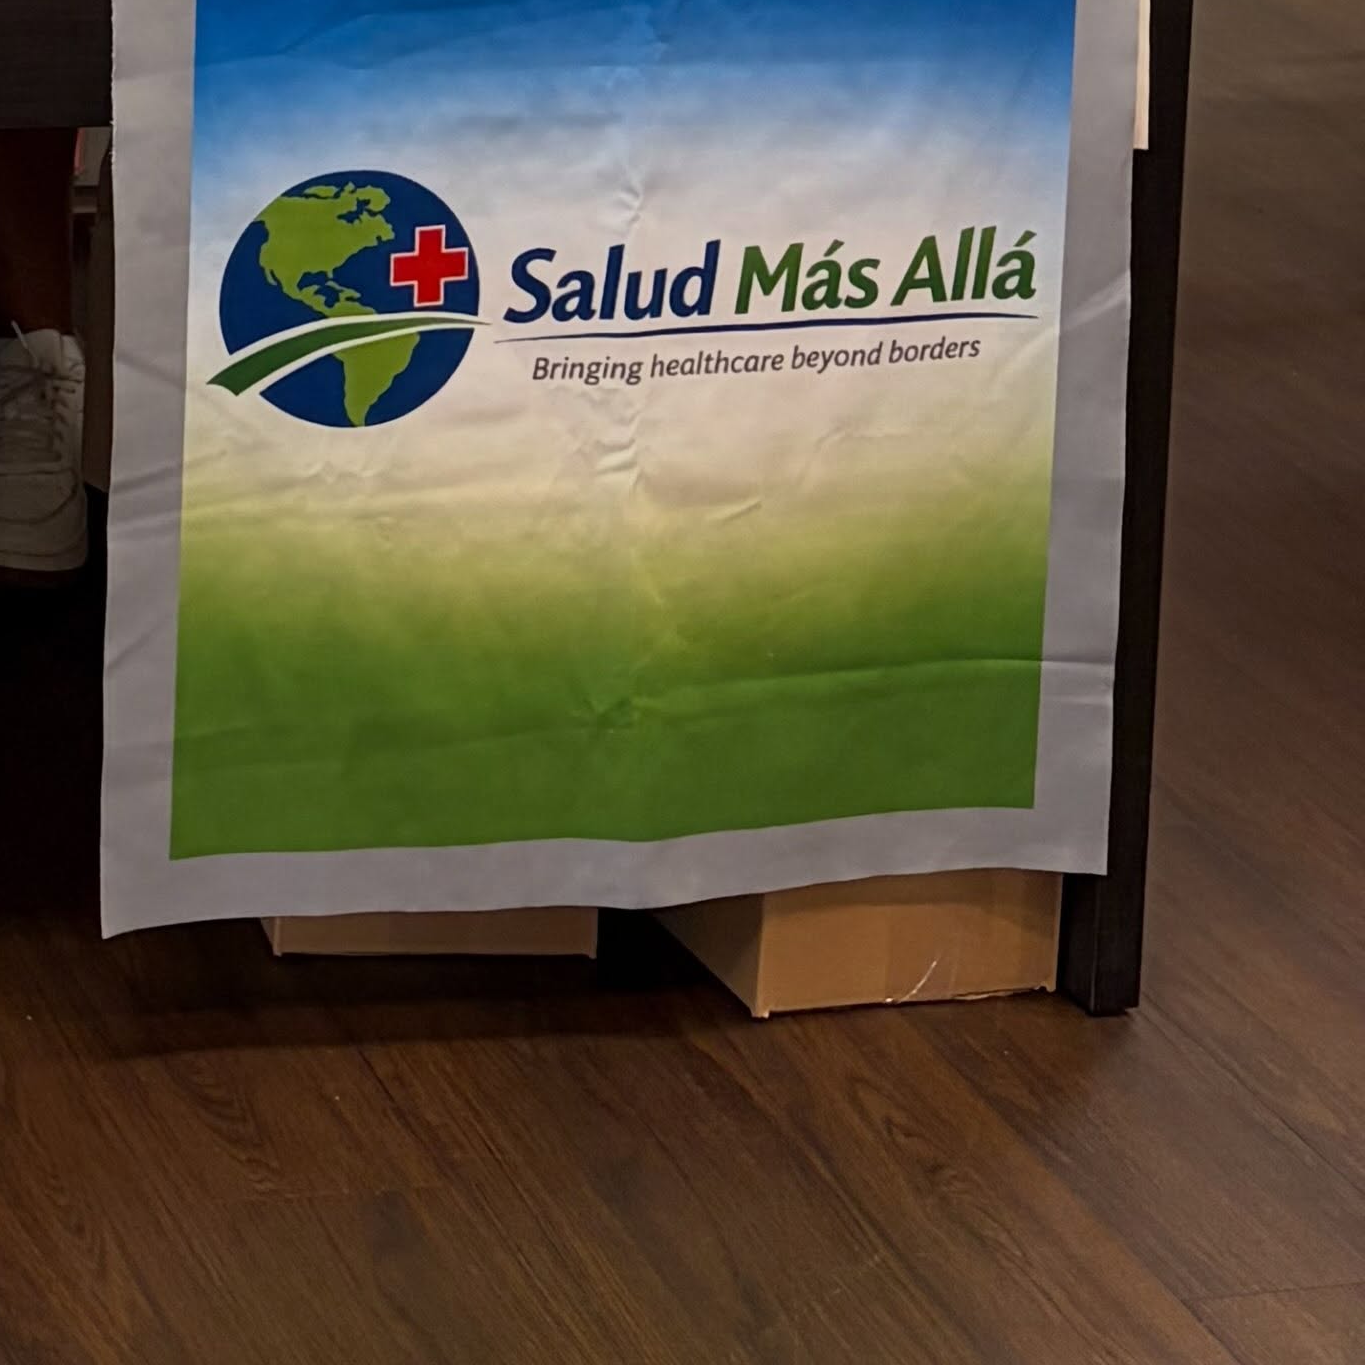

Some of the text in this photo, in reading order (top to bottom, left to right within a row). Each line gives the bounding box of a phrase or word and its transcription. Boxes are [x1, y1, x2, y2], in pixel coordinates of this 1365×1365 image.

[504, 226, 1037, 323] Salud Más Allá
[531, 335, 981, 386] Bringing healthcare beyond borders
